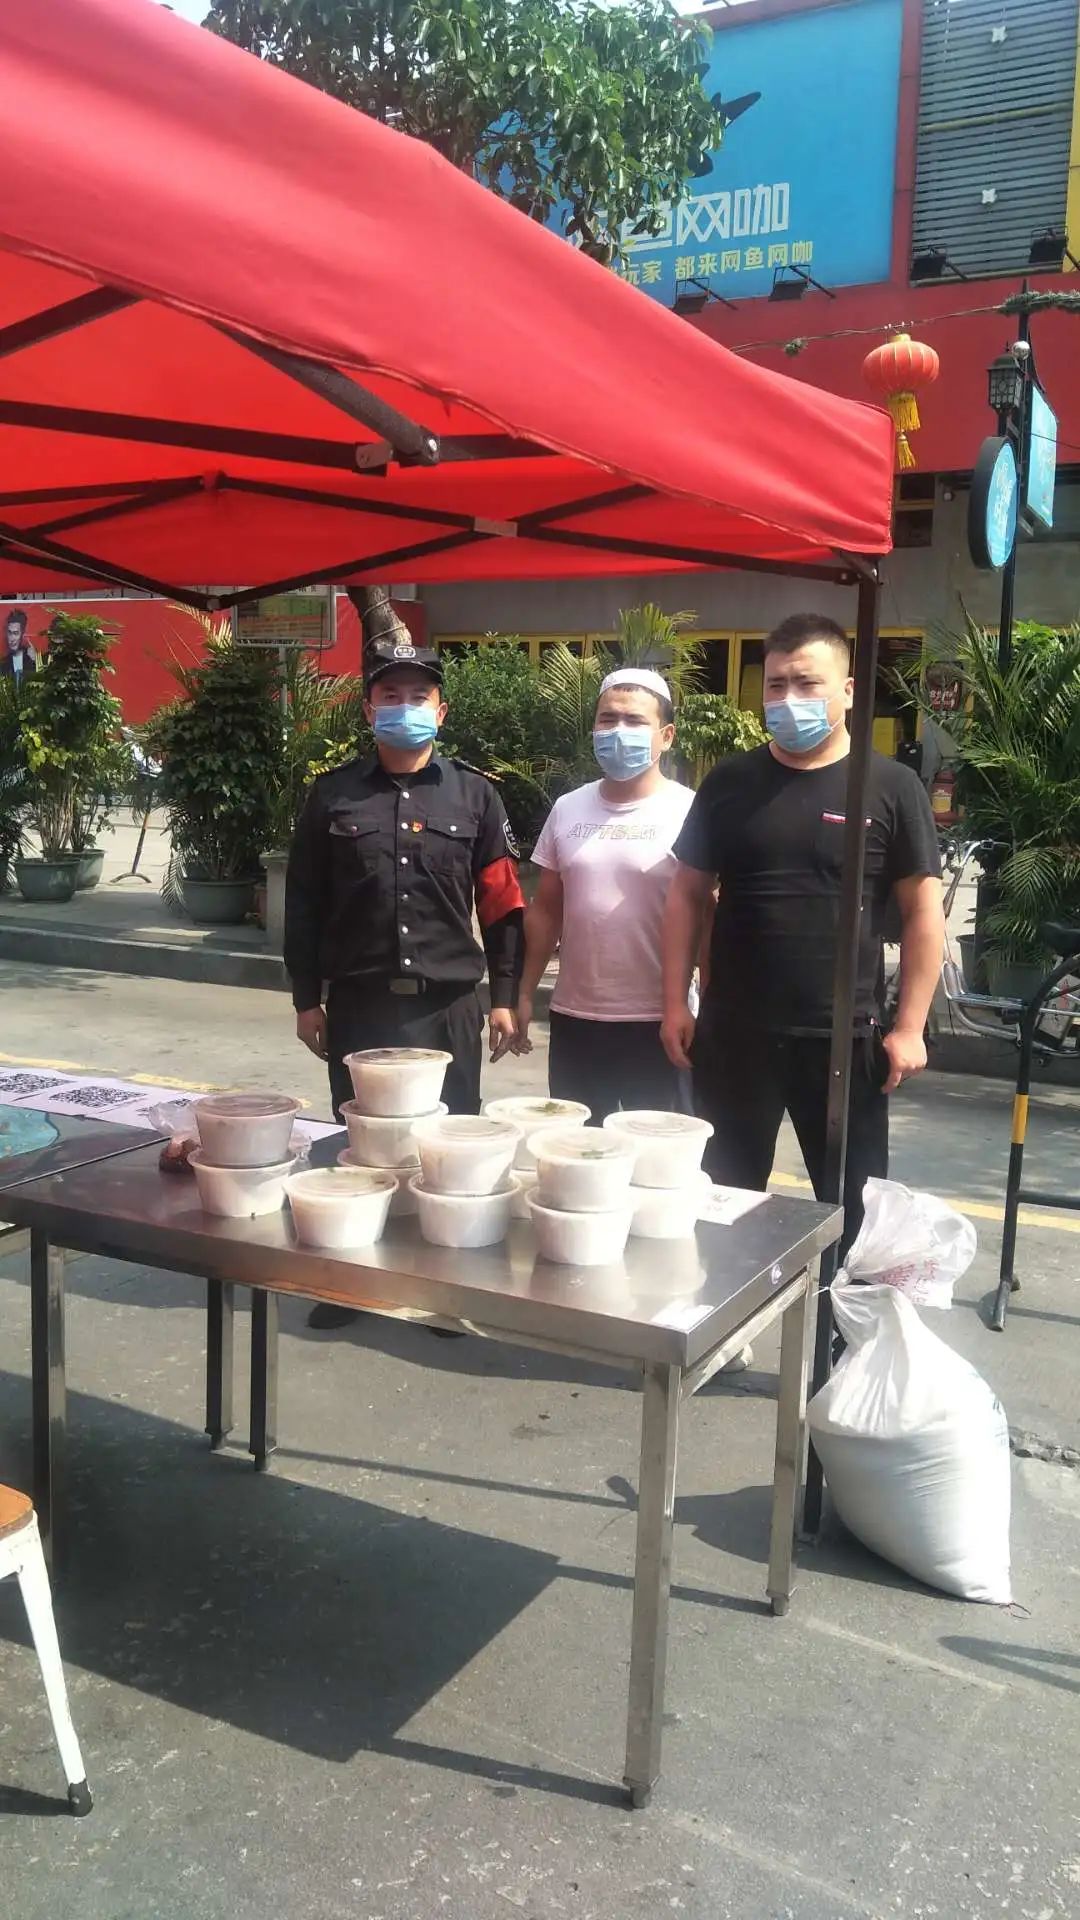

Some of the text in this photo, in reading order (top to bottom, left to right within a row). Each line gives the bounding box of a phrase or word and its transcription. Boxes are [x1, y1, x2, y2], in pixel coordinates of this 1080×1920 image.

[675, 240, 813, 279] 都来网鱼网咖
